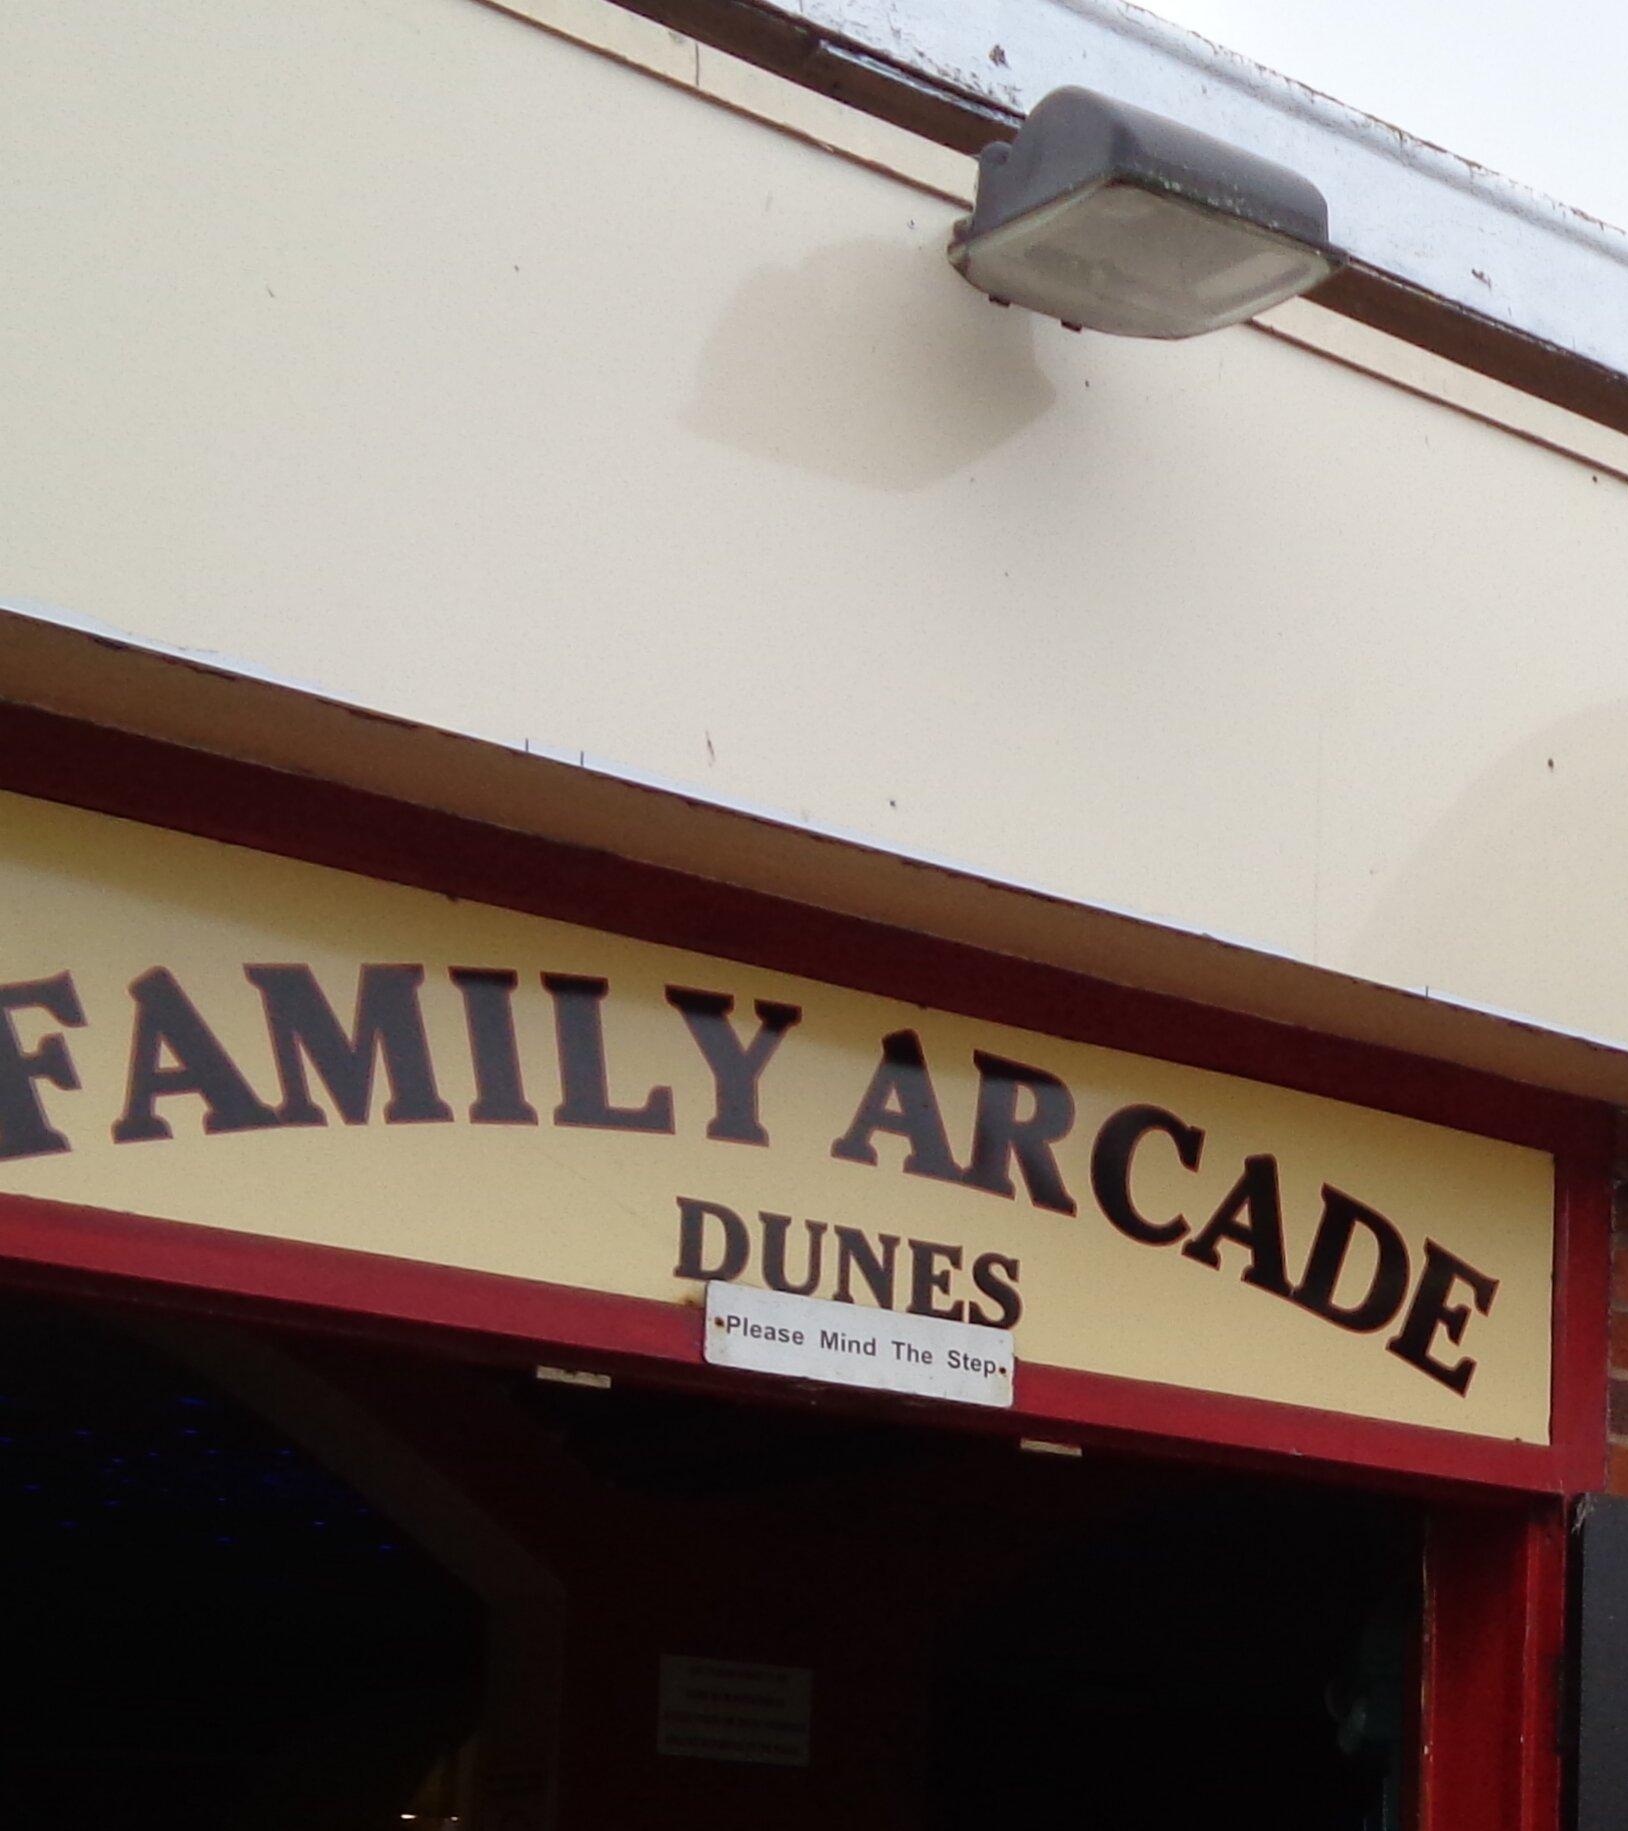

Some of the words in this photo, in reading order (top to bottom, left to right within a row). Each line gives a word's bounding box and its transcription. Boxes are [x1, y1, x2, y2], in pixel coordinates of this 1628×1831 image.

[0, 963, 803, 1162] FAMILY
[830, 1028, 1501, 1398] ARCADE
[673, 1197, 1024, 1331] DUNES
[726, 1315, 804, 1346] Please
[820, 1330, 876, 1356] Mind
[891, 1340, 933, 1365] The
[947, 1350, 997, 1378] Step
